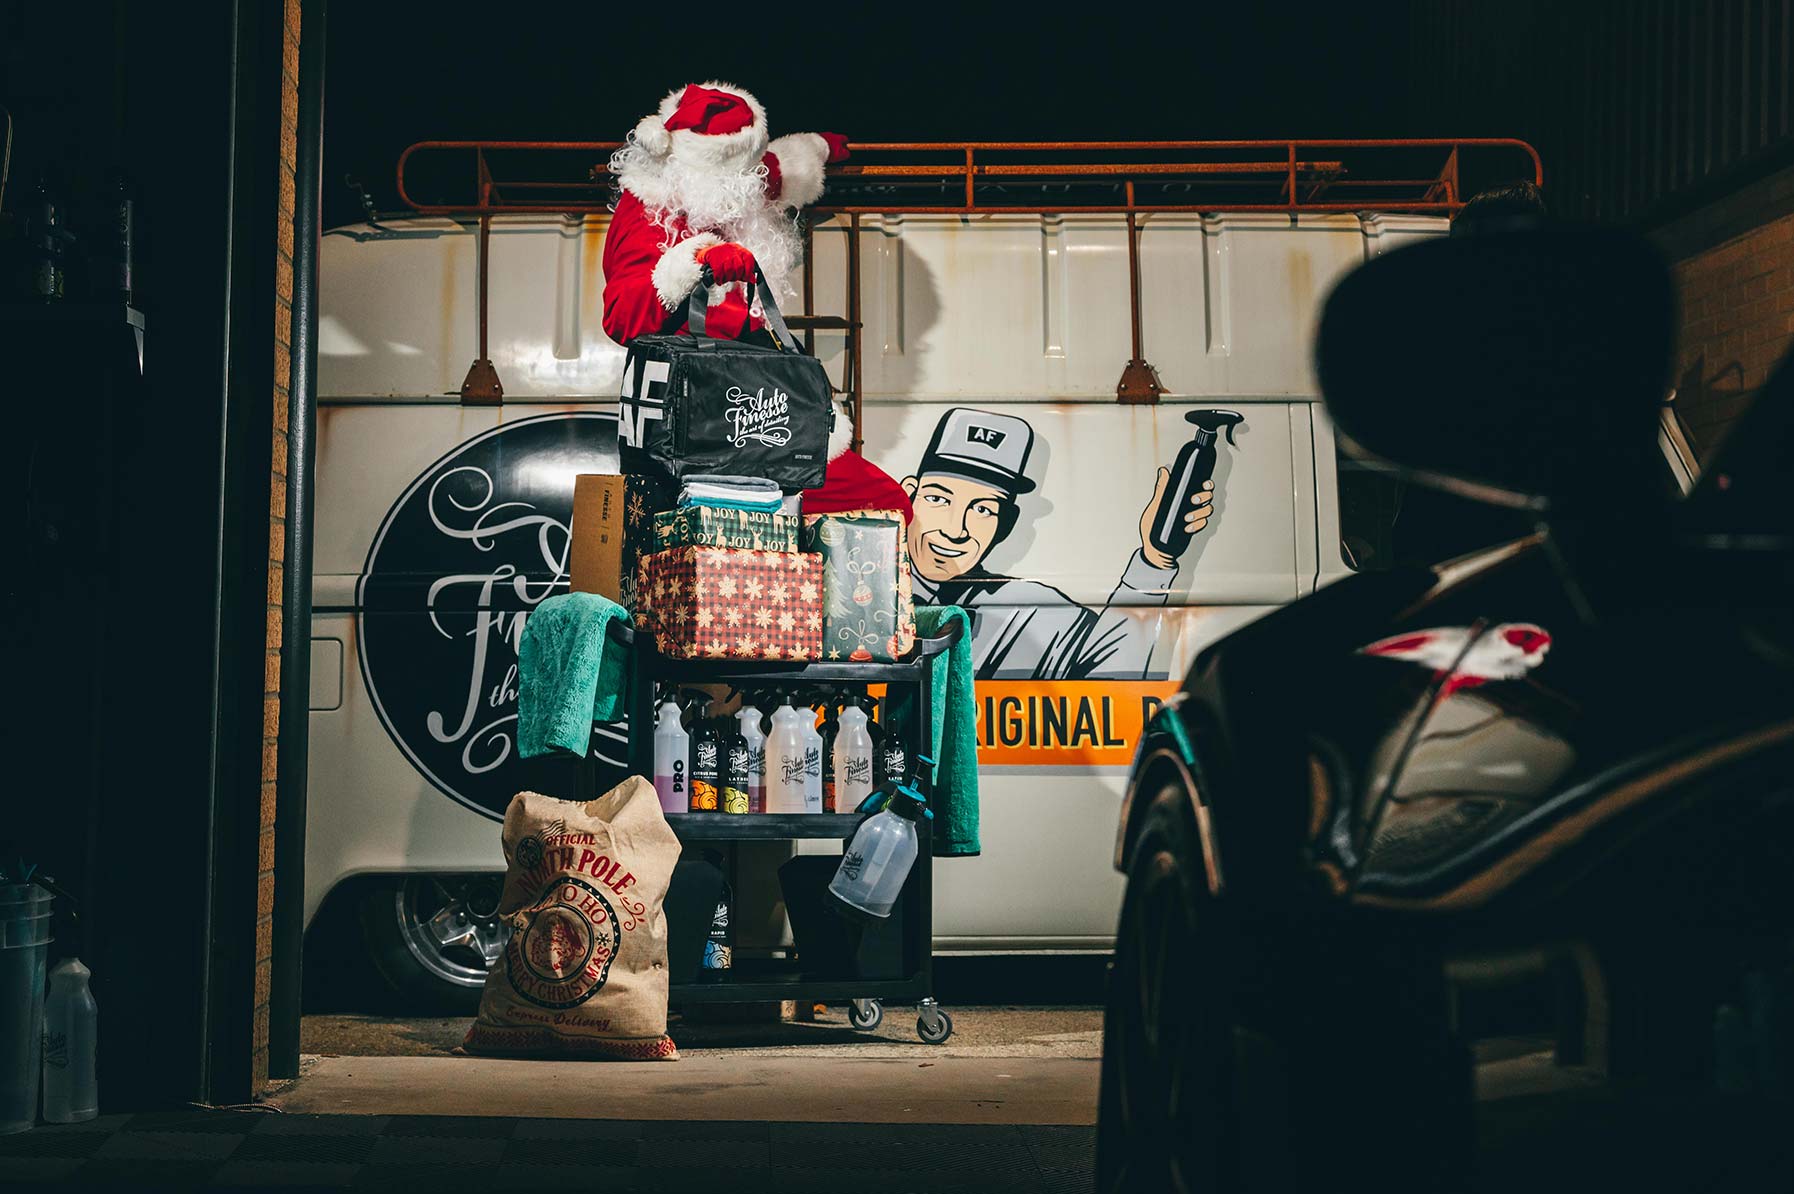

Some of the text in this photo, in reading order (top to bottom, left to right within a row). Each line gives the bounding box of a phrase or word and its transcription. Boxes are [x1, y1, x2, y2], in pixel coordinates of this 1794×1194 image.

[727, 386, 788, 412] Auto
[725, 402, 788, 442] Finesse
[973, 426, 998, 443] AF
[714, 507, 799, 527] JOY JOY JO
[728, 536, 751, 549] JOY
[764, 540, 785, 552] JOY
[489, 664, 519, 708] th
[975, 696, 1126, 748] IGINAL
[673, 759, 684, 793] PRO
[546, 834, 596, 846] OFFICIAL
[577, 848, 637, 896] POLE
[578, 894, 607, 924] HO
[537, 946, 611, 999] CHRISTMAS
[553, 1011, 611, 1032] Delivery
